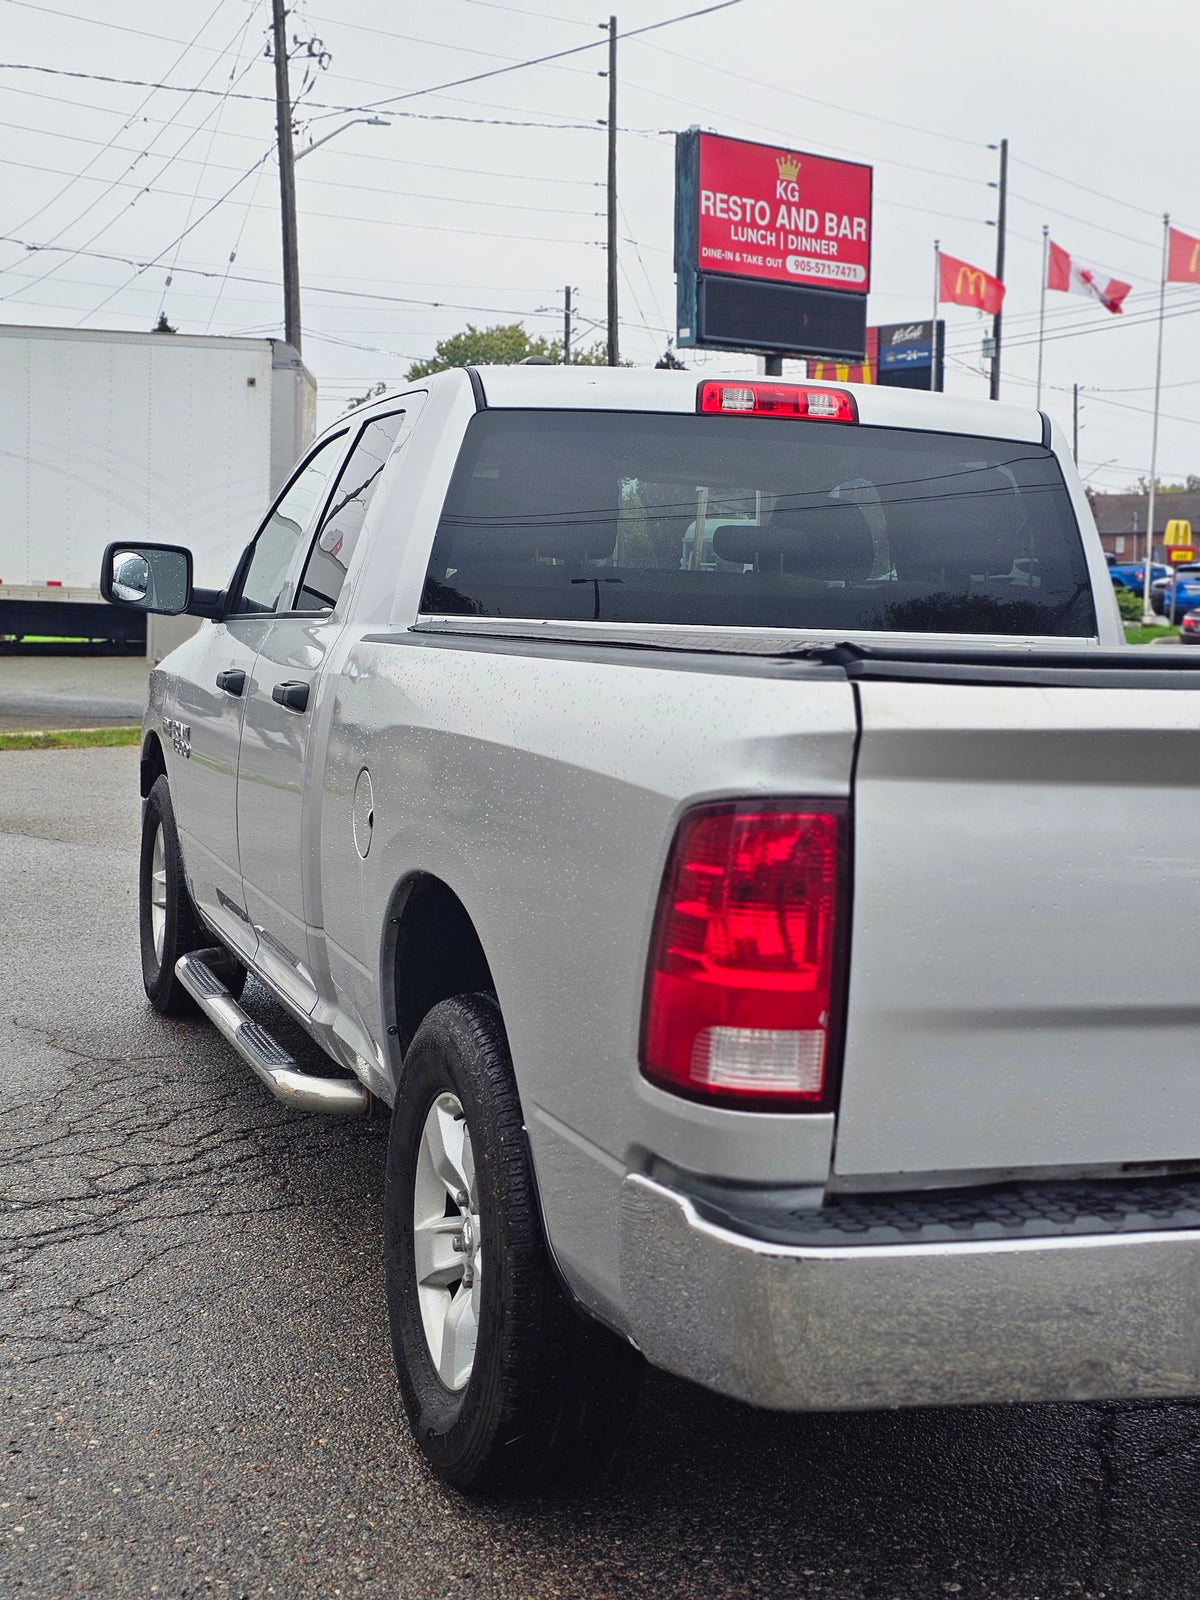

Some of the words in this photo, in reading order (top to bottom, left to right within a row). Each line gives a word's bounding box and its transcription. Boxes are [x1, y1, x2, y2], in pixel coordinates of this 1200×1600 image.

[776, 180, 799, 202] KG
[700, 190, 771, 226] RESTO
[775, 205, 819, 233] AND
[824, 212, 867, 242] BAR
[731, 225, 776, 246] LUNCH
[788, 235, 838, 256] DINNER
[701, 247, 733, 261] DINE-IN
[735, 252, 741, 262] &
[742, 253, 764, 265] TAKE
[765, 257, 783, 268] OUT
[794, 259, 858, 278] 905-571-7471
